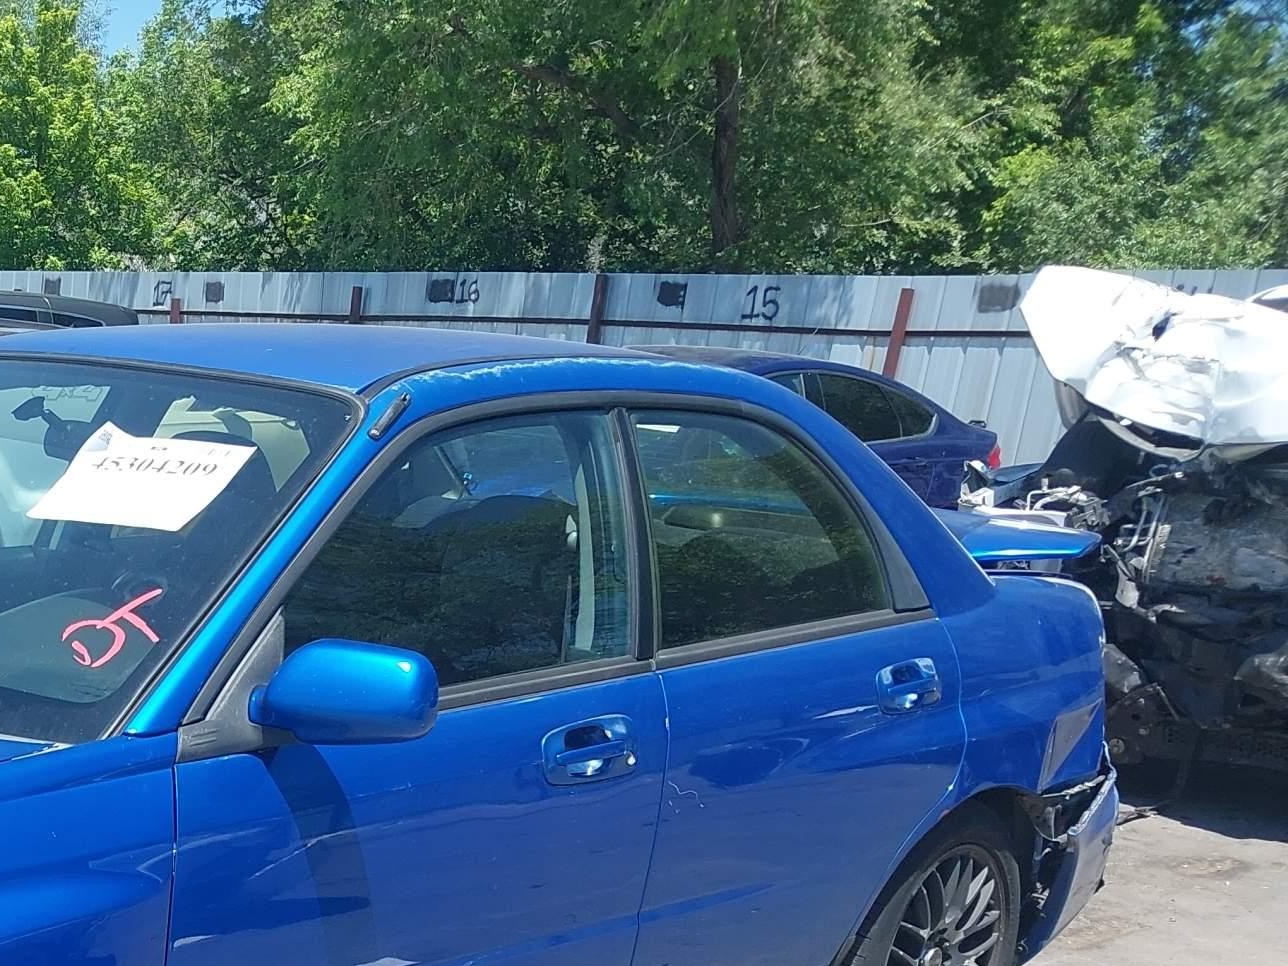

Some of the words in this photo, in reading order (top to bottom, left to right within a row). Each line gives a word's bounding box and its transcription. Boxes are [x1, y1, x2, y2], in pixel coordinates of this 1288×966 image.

[456, 278, 480, 304] 16
[740, 284, 782, 322] 15
[92, 456, 218, 477] 45304209
